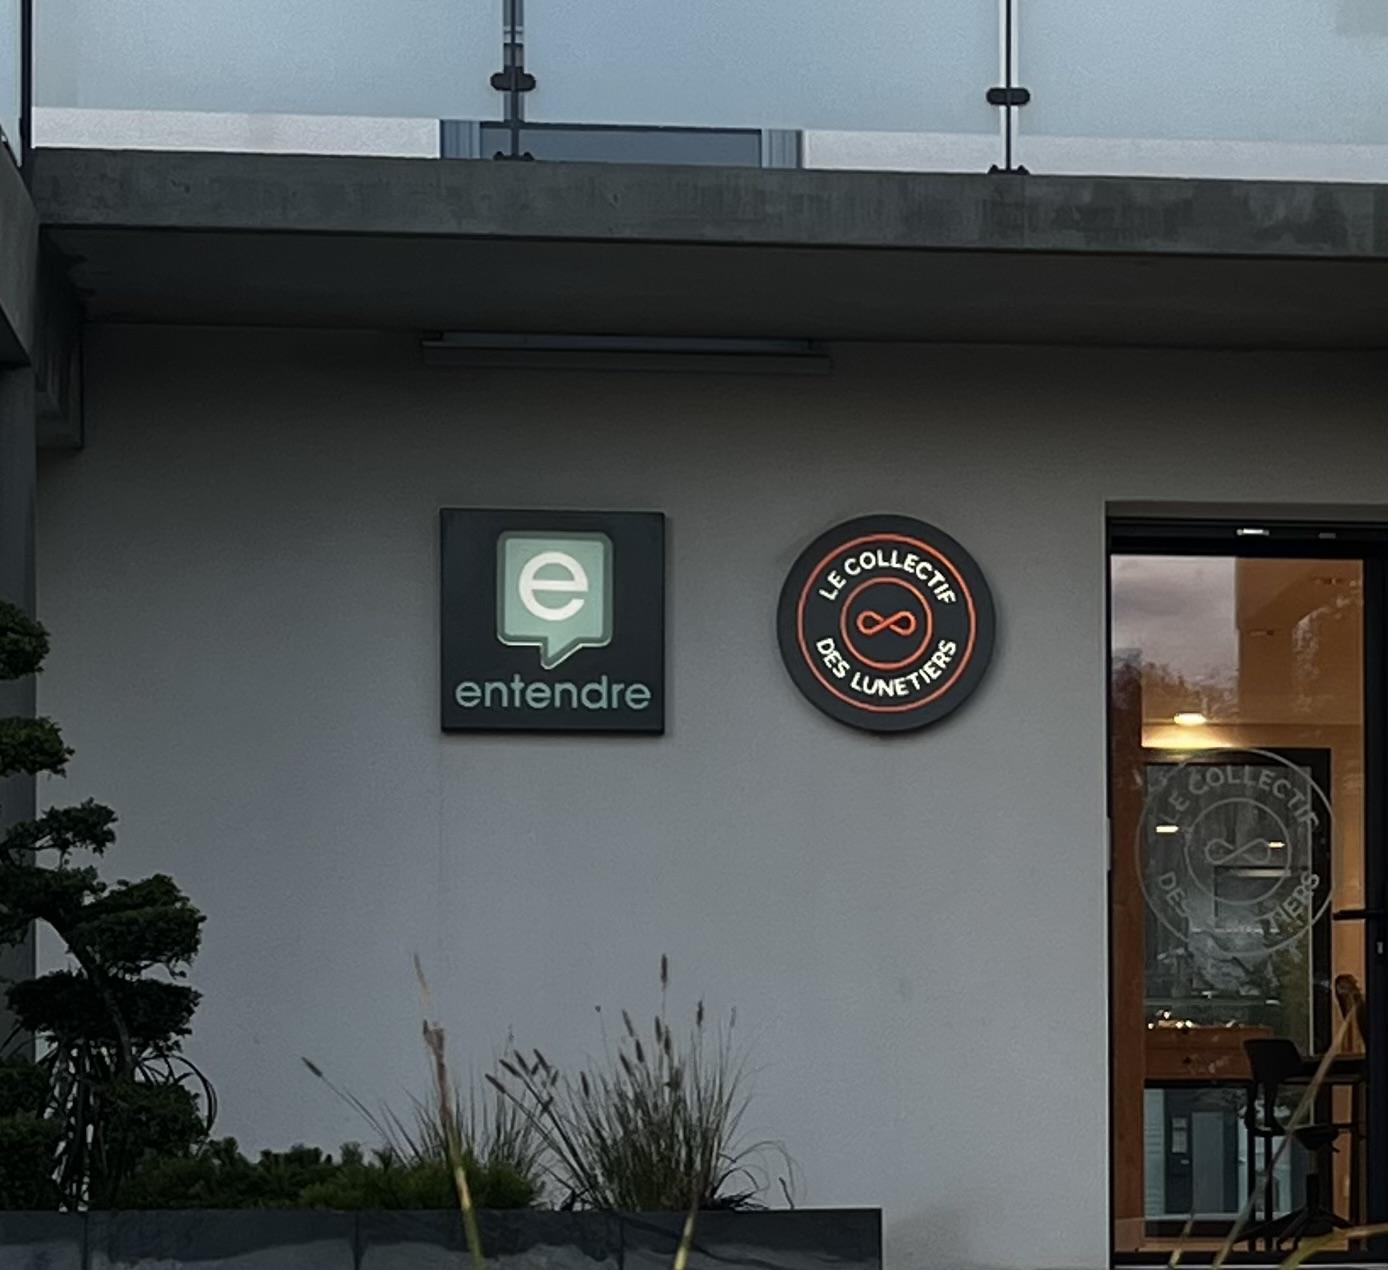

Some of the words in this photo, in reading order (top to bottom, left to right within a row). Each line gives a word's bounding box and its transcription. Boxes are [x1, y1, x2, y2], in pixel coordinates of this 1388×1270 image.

[518, 551, 589, 621] e
[819, 570, 847, 600] LE
[844, 549, 957, 603] COLLECTIF
[455, 674, 652, 710] entendre
[816, 637, 850, 679] DES
[850, 639, 957, 697] LUNETIERS
[1188, 764, 1320, 828] COLLECTIF
